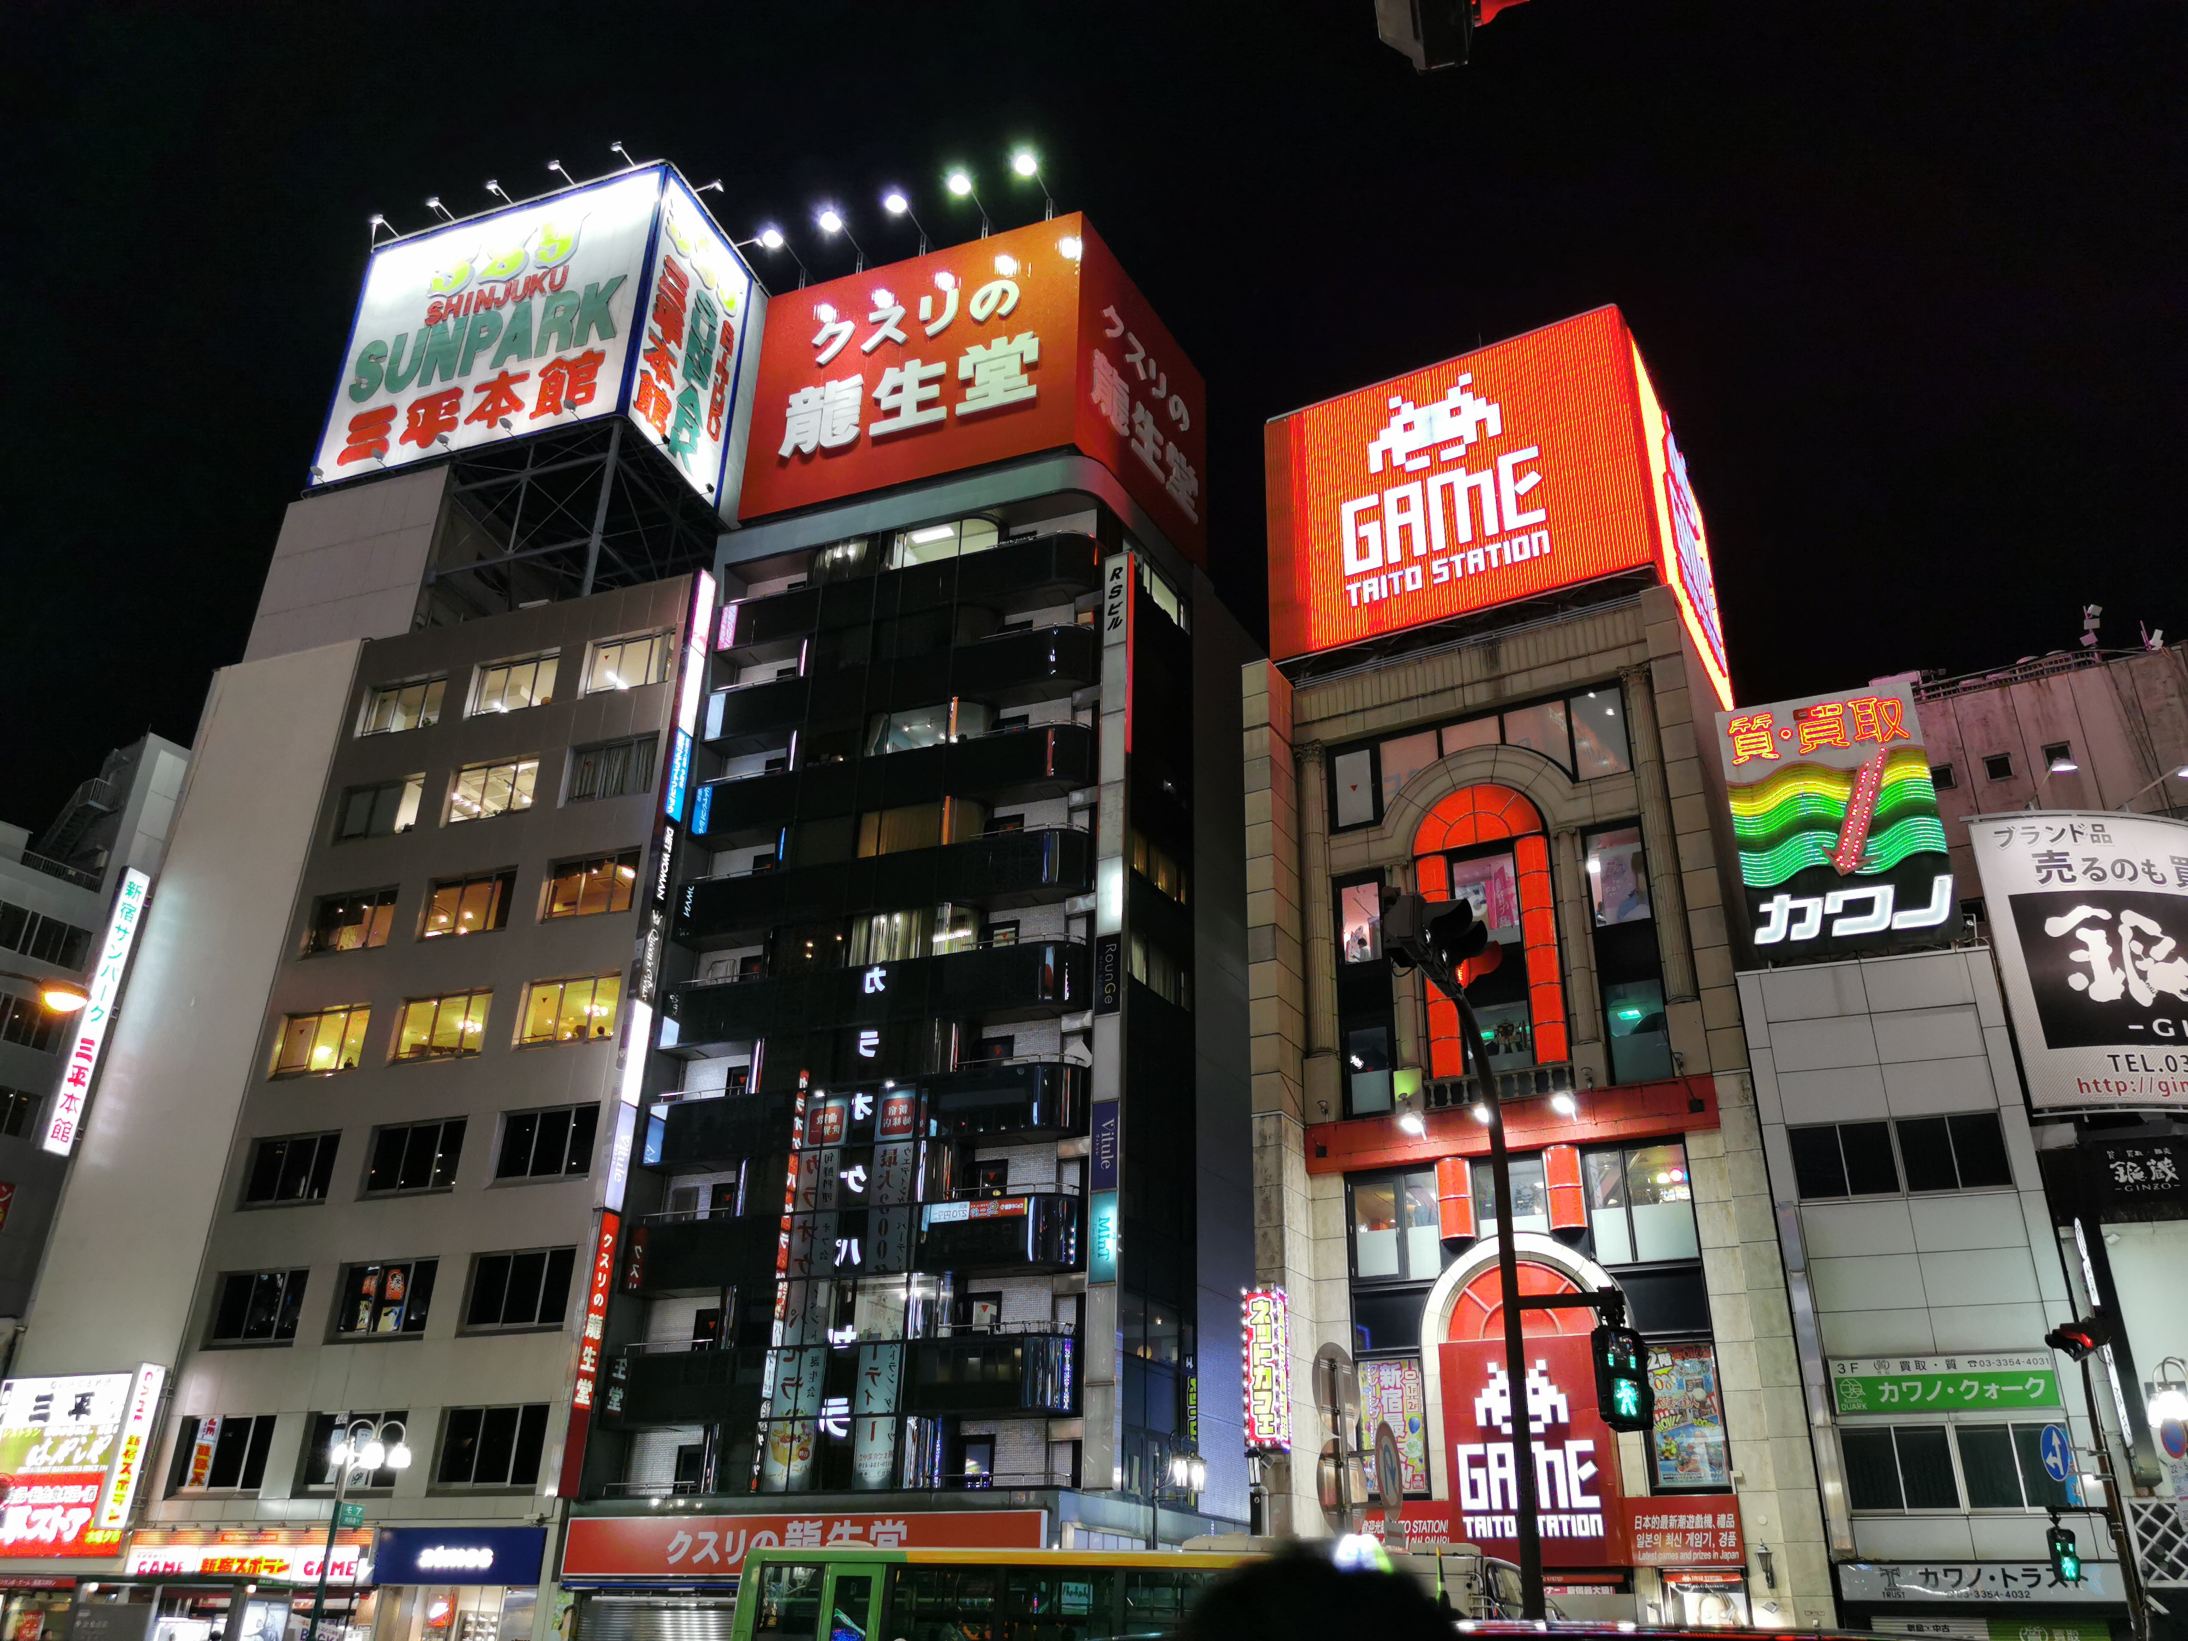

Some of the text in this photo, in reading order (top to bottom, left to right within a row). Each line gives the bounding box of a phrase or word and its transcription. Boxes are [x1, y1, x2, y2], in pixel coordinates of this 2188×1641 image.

[425, 266, 569, 327] SHINJUKU
[811, 279, 1021, 365] クスリの
[349, 274, 628, 403] SUNPARK
[337, 349, 606, 466] 三平本館
[778, 331, 1040, 460] 龍生堂
[1341, 445, 1546, 576] GAME
[1346, 529, 1551, 607] TAITO STATION
[1727, 697, 1911, 766] 質・買取
[1994, 823, 2113, 849] ブランド品
[656, 853, 673, 901] WOMAN
[1754, 874, 1955, 945] カワノ
[90, 880, 144, 1024] 新宿サンパーク
[50, 1037, 96, 1144] 三平本館
[1100, 1118, 1116, 1171] Vitule
[574, 1233, 613, 1406] クスリの龍生堂
[1251, 1299, 1275, 1438] ネットカフェ
[1878, 1377, 2046, 1404] カワノ・クォーク
[1979, 1357, 2050, 1368] 03-3354-4031
[28, 1391, 95, 1423] 三平
[1462, 1514, 1604, 1539] TAITO TATION
[1636, 1532, 1662, 1548] 일본의
[1665, 1532, 1682, 1548] 최신
[1719, 1531, 1737, 1548] 경품
